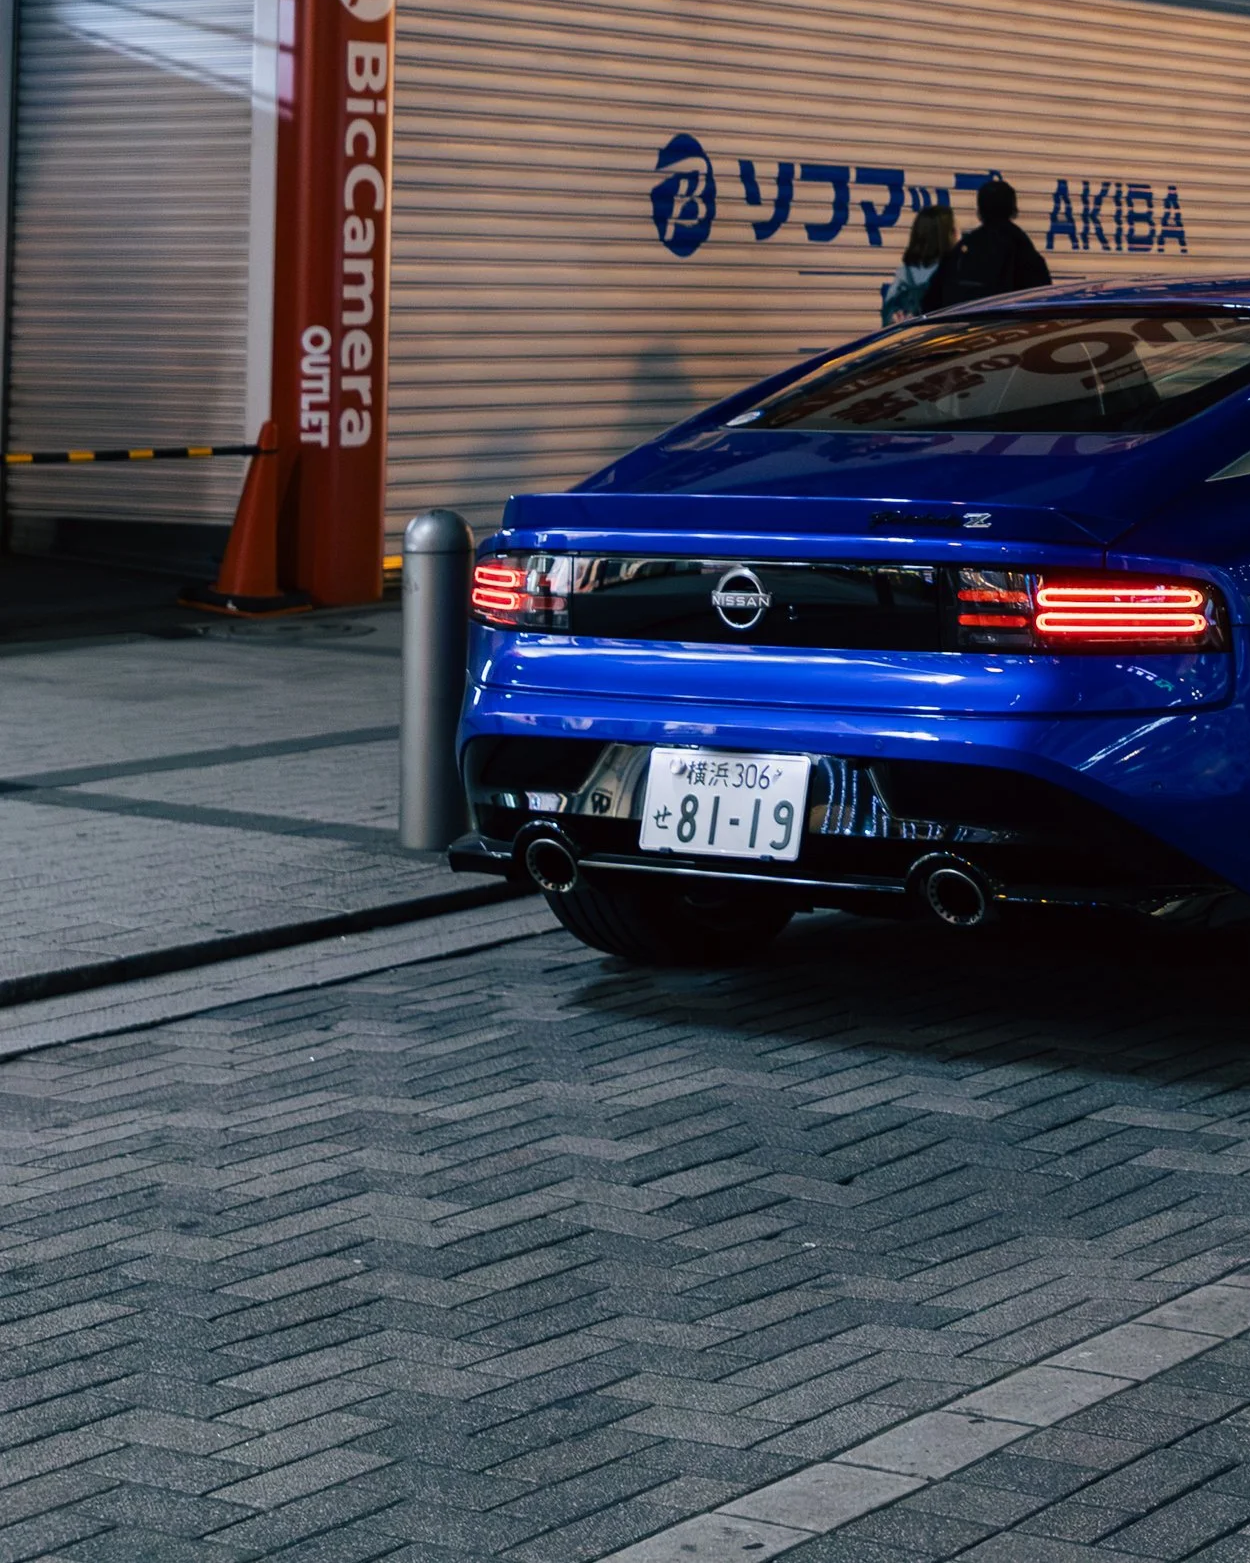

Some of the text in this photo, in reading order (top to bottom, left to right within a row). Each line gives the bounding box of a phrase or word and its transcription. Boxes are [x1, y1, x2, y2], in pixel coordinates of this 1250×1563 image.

[338, 40, 388, 449] BicCamera
[1045, 178, 1188, 254] AKIBA
[300, 324, 333, 449] OUTLET
[963, 513, 992, 529] Z
[711, 592, 771, 609] NISSAN
[653, 793, 794, 851] せ 81-19
